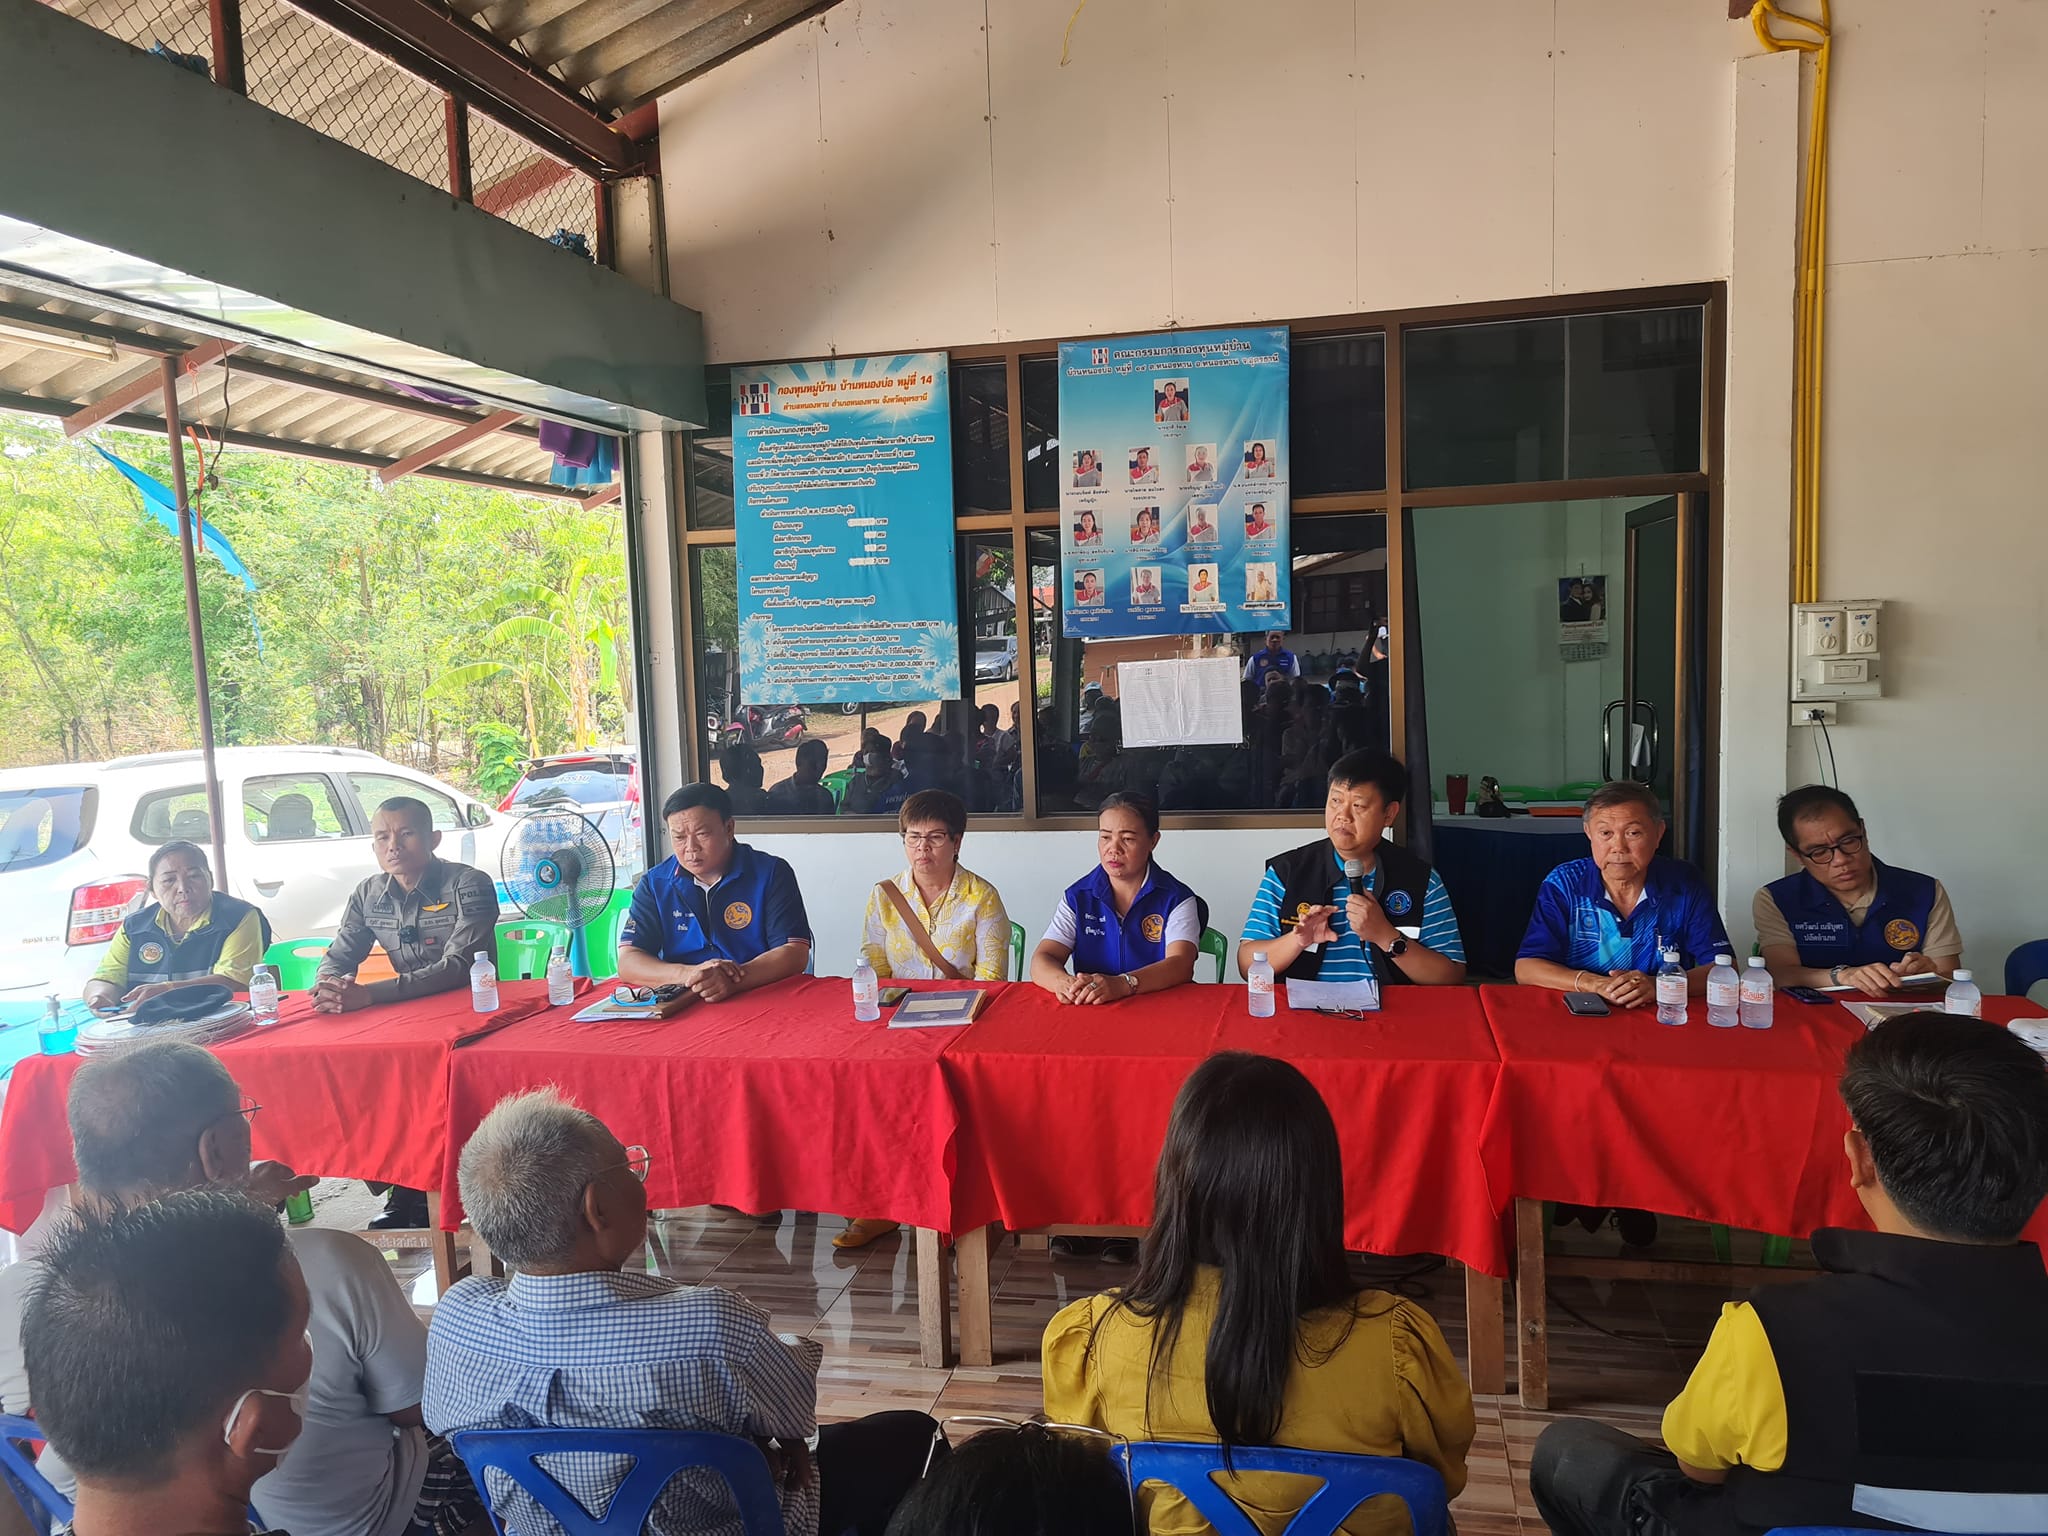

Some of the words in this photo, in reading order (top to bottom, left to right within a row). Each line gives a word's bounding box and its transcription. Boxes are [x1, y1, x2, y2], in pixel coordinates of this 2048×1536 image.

[1114, 338, 1250, 359] คณะกรรมการกองทุนหมู่บ้าน
[778, 381, 836, 398] กองทุนหมู่บ้าน
[840, 377, 893, 391] บ้านหนองบ่อ
[897, 372, 916, 390] หมู่ที่
[920, 375, 932, 385] 14
